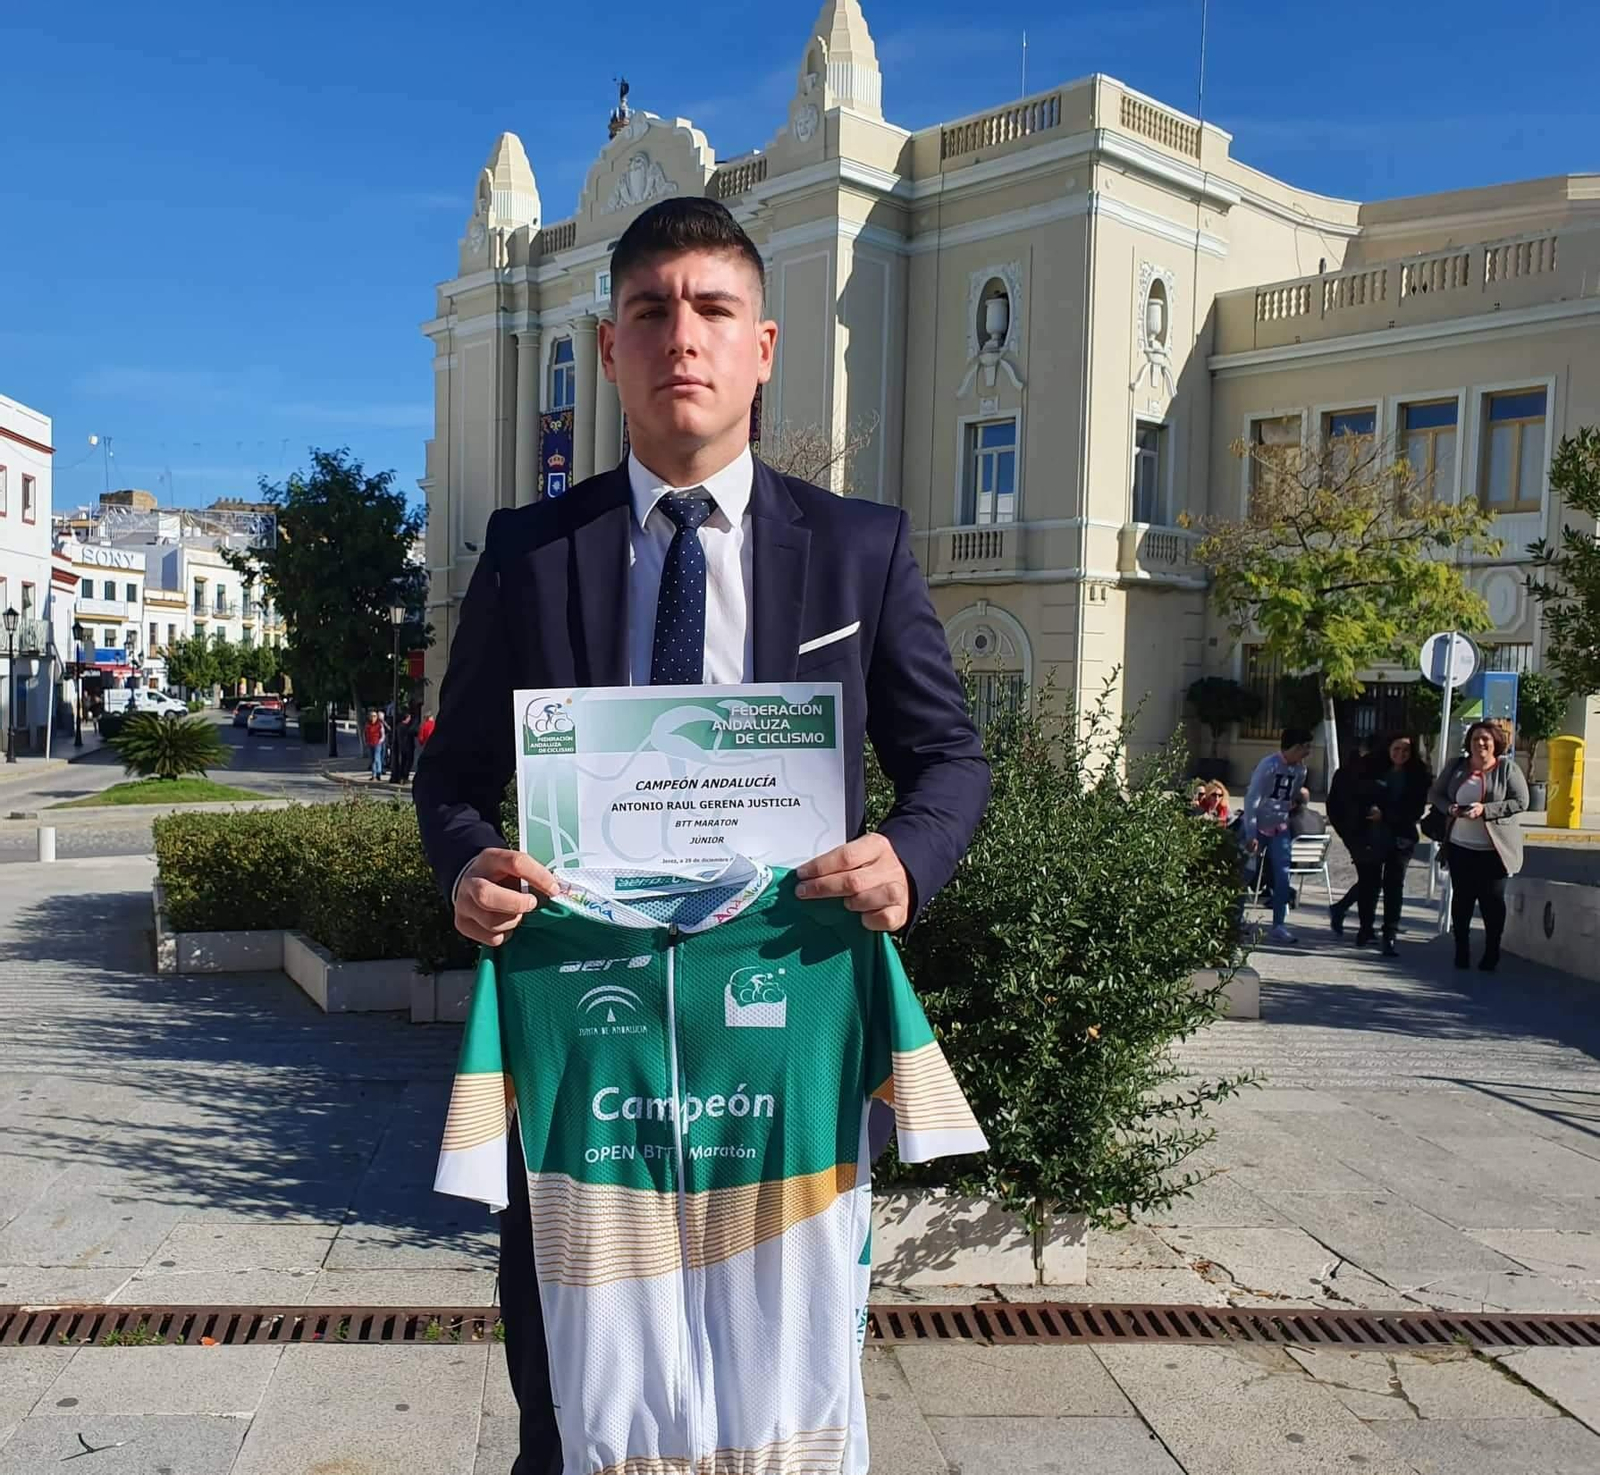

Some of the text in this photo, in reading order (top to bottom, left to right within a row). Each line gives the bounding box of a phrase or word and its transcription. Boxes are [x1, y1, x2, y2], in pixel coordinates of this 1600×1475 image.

[81, 545, 134, 569] SONY
[730, 702, 823, 717] FEDERACIÓN
[712, 718, 790, 732] ANDALUZA
[735, 731, 825, 745] DE CICLISMO
[635, 773, 777, 791] CAMPEÓN ANDALUCÍA
[1269, 773, 1295, 801] H
[611, 797, 801, 812] ANTONIO RAUL GERENA JUSTICIA
[674, 817, 739, 828] BTT MARATON
[689, 834, 725, 845] JÚNIOR
[591, 1082, 775, 1135] Campeón
[585, 1144, 636, 1164] OPEN
[688, 1143, 757, 1162] Maratón
